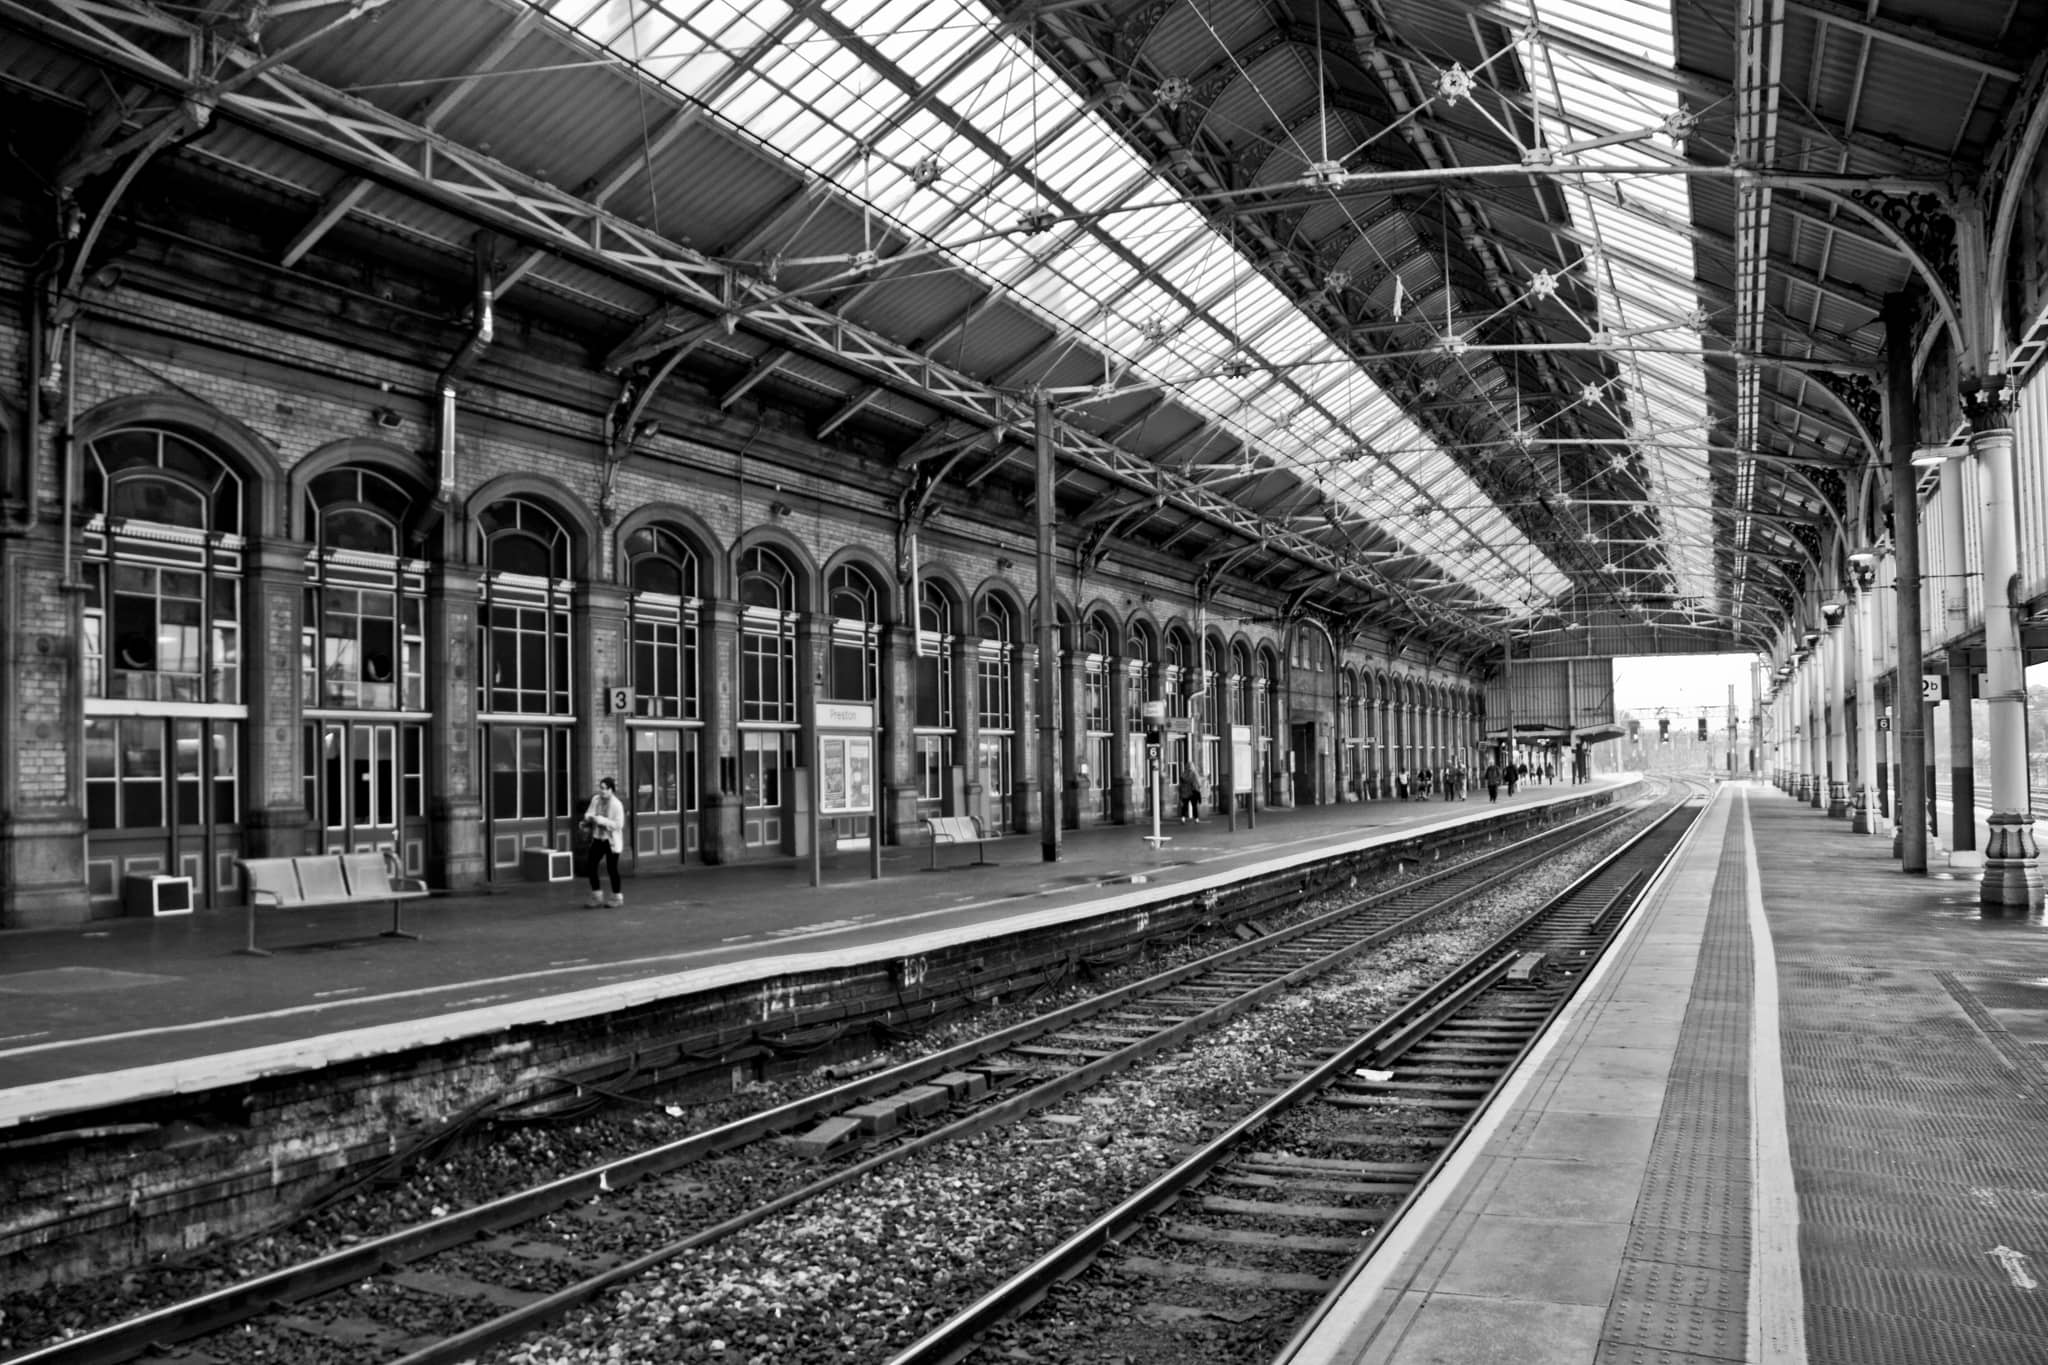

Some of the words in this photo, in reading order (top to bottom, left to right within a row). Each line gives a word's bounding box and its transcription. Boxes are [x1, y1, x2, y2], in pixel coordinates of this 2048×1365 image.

[615, 691, 627, 709] 3
[830, 709, 857, 721] Preston
[1880, 719, 1888, 729] 6
[1150, 747, 1157, 757] 6
